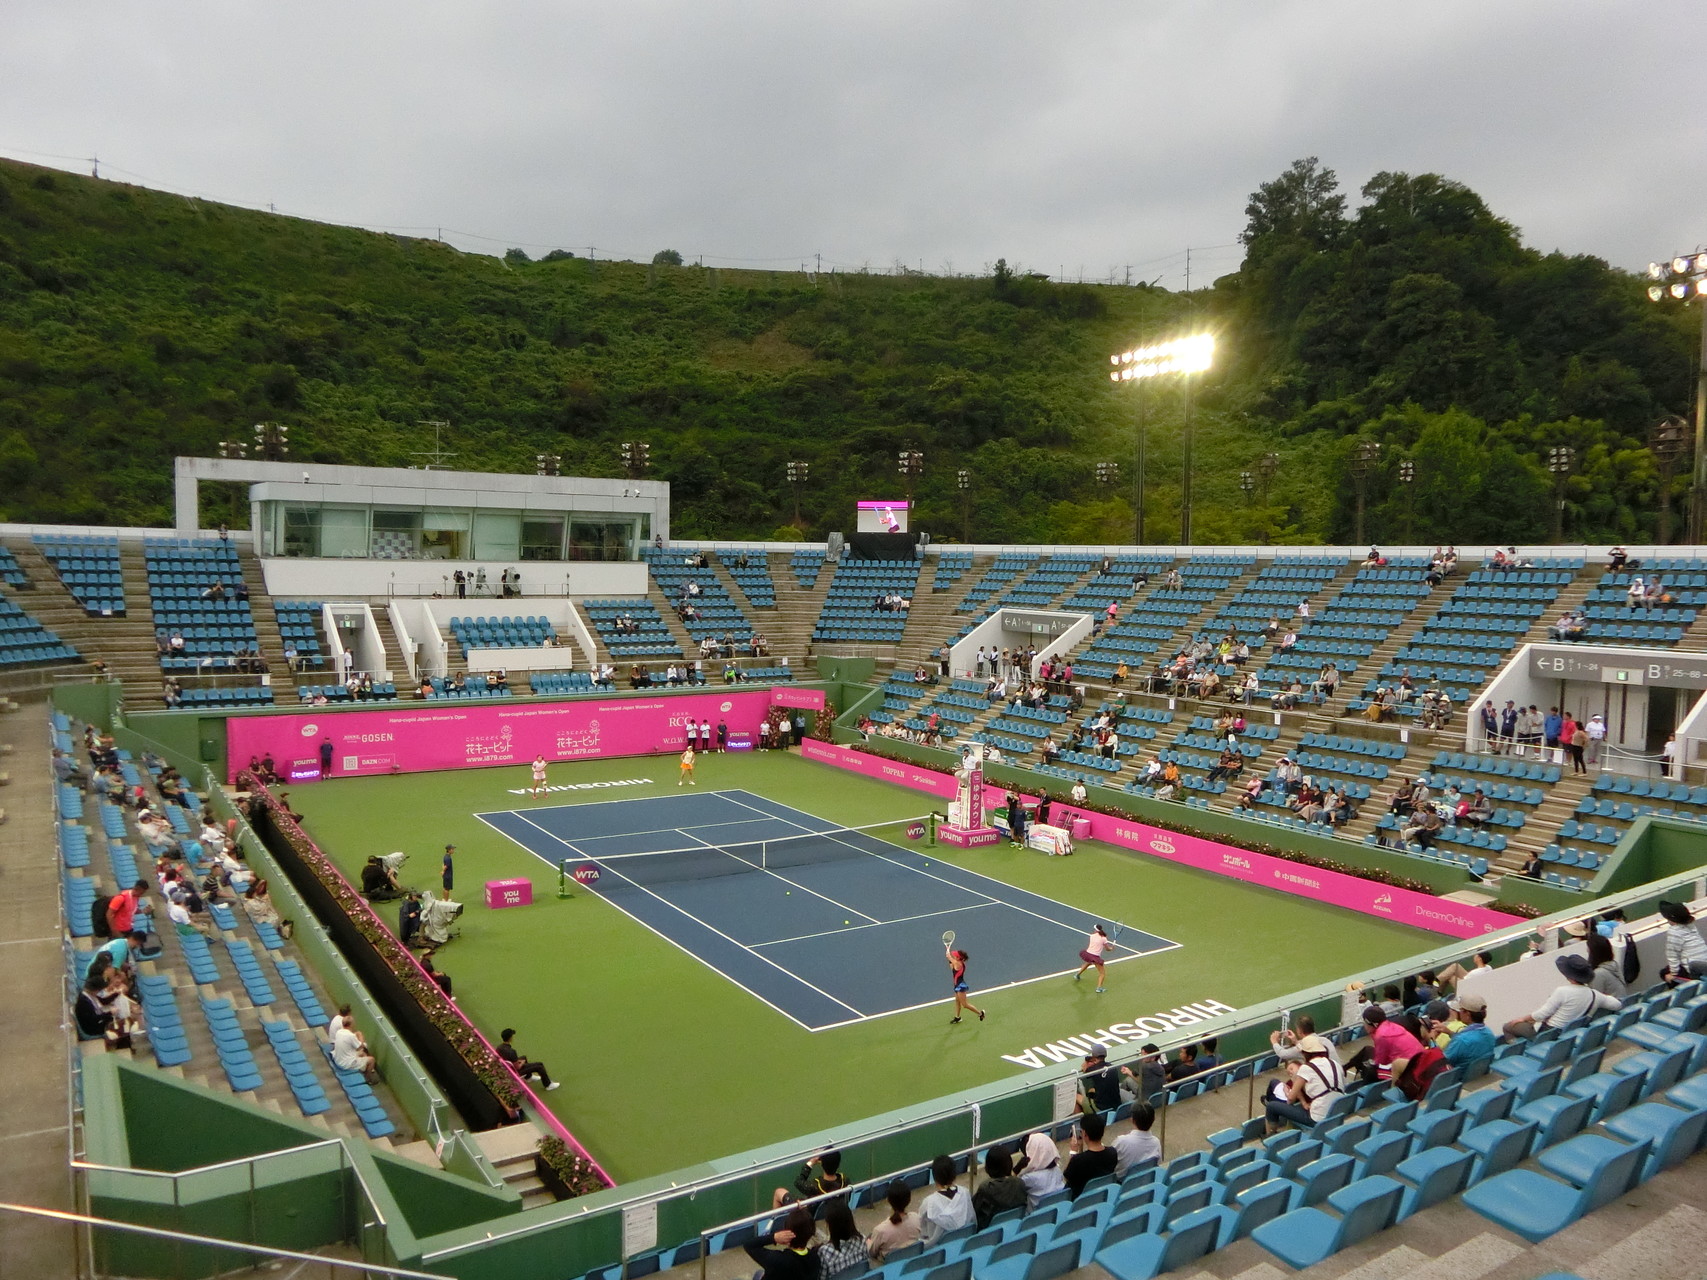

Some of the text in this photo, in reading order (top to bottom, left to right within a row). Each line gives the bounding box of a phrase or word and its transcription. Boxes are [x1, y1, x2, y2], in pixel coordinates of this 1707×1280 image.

[1011, 617, 1017, 627] A
[1050, 620, 1057, 630] A
[1553, 657, 1565, 672] B
[1648, 664, 1661, 679] B
[361, 732, 393, 743] GOSEN
[556, 736, 600, 748] 花キューピット
[465, 741, 513, 754] 花キューピット
[882, 765, 905, 778] TOPPAN
[972, 783, 981, 828] ゆめタウン
[907, 825, 926, 836] WTA
[1116, 827, 1139, 842] 林病院
[575, 870, 600, 879] WTA
[503, 889, 519, 899] you
[1415, 905, 1475, 929] DreamOnline
[1000, 999, 1238, 1069] HIROSHIMA
